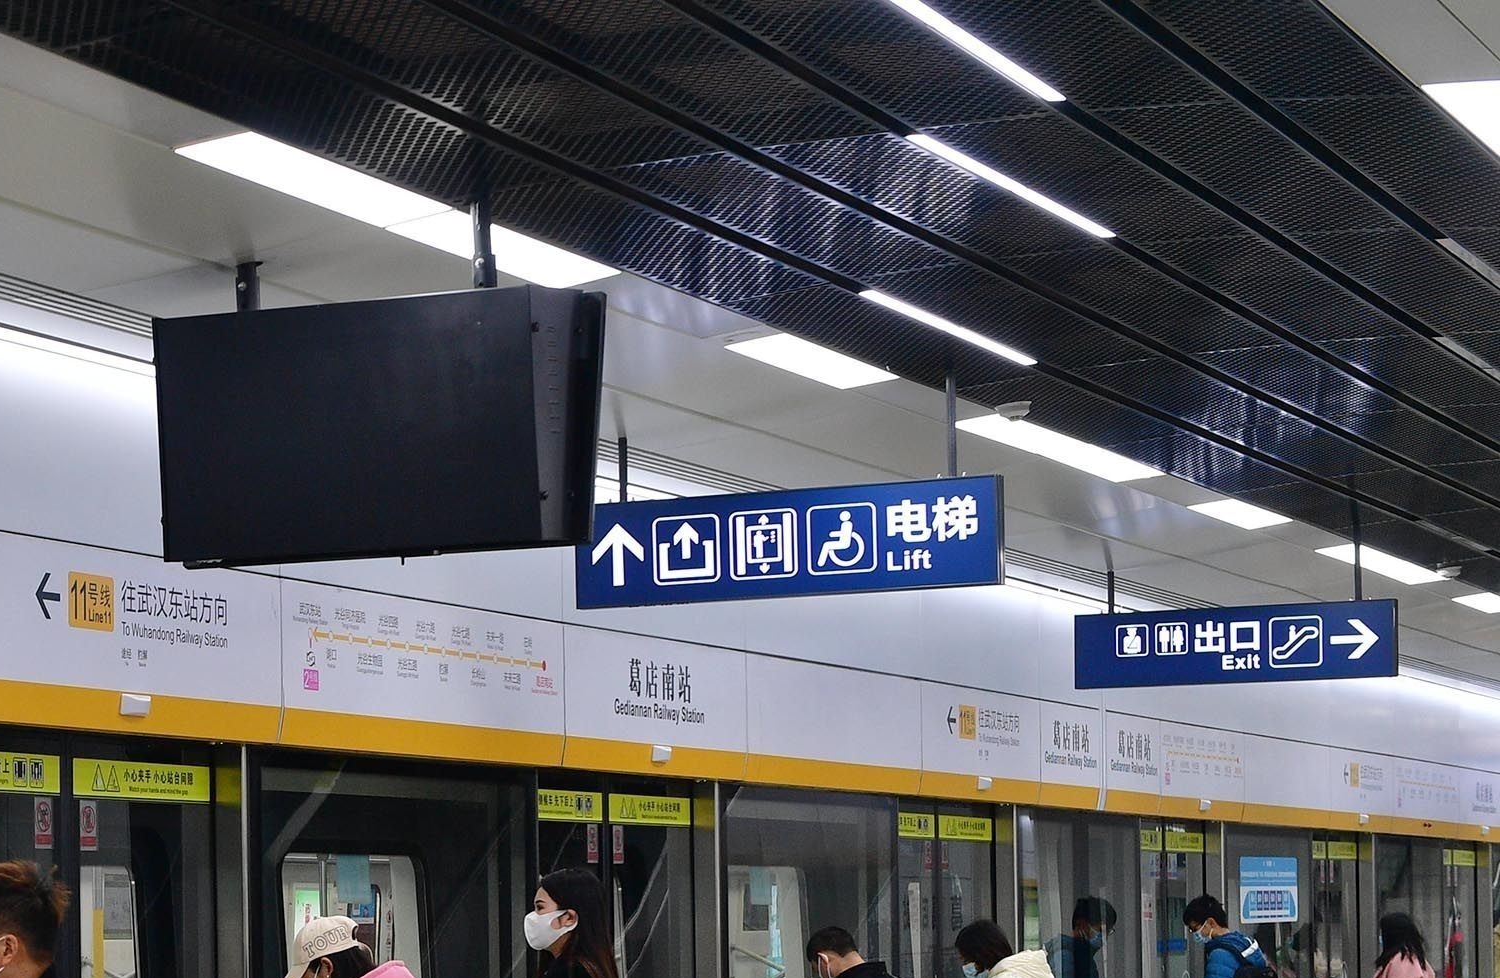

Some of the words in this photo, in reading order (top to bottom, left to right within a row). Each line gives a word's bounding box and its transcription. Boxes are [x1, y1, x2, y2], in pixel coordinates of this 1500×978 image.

[886, 494, 979, 543] 电梯
[886, 548, 932, 572] Lift
[121, 580, 228, 626] 往武汉东站方向
[121, 621, 130, 636] To
[131, 622, 175, 646] Wuhandong
[176, 628, 203, 649] Railway
[204, 632, 228, 649] Station
[1194, 620, 1260, 653] 出口
[1222, 653, 1260, 670] Exit
[629, 658, 691, 704] 葛店南站
[614, 698, 652, 718] Gediannan
[653, 703, 680, 725] Railway
[681, 706, 705, 724] Station
[1053, 720, 1090, 753] 葛店南站
[1118, 729, 1151, 761] 葛店南站
[123, 768, 151, 783] 小心夹手
[302, 925, 350, 958] TOUR
